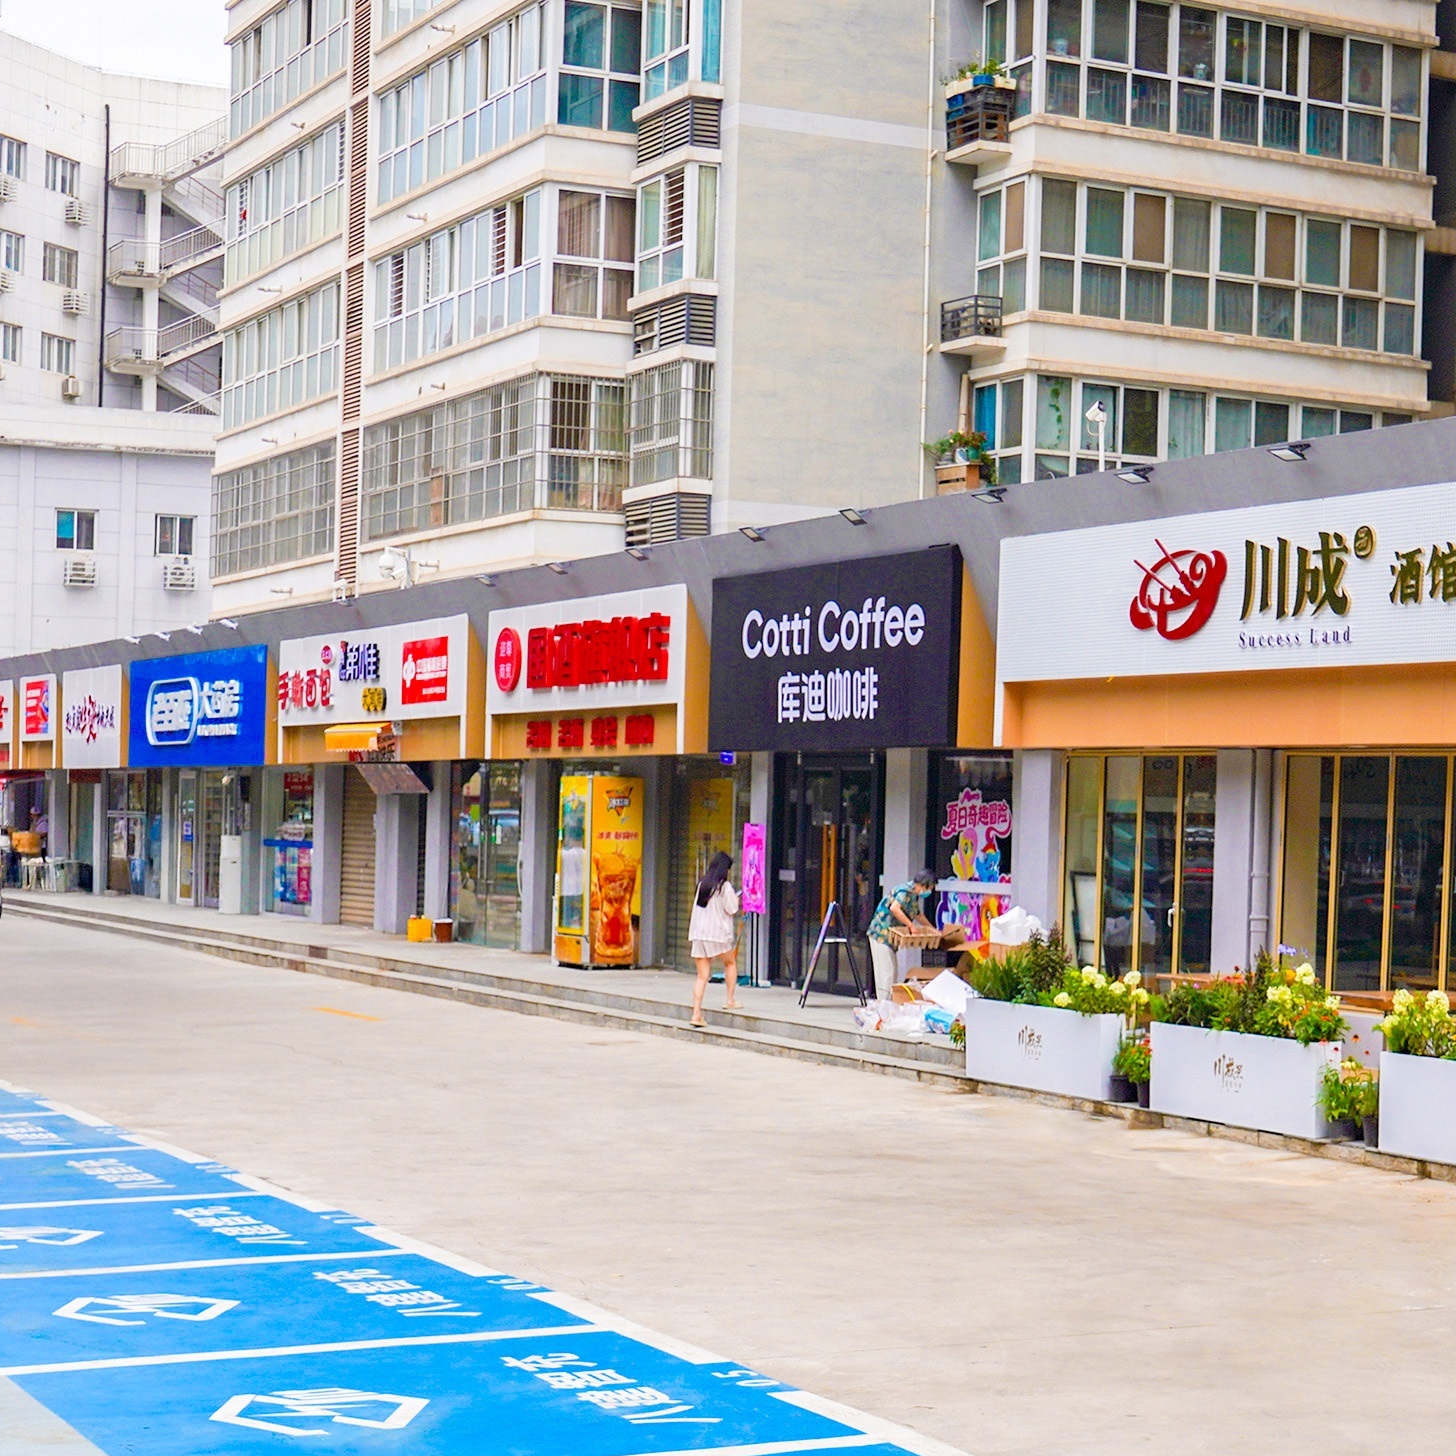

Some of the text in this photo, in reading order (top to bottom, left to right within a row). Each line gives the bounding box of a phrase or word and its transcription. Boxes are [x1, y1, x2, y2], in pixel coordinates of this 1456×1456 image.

[741, 596, 926, 660] Cotti Coffee
[1239, 625, 1352, 649] Success Land
[777, 666, 879, 724] 库迪咖啡
[946, 801, 1009, 834] 夏日奇趣冒险
[311, 1268, 483, 1317] 八建智充
[499, 1352, 724, 1424] 八建智充
[711, 1369, 781, 1388] 05
